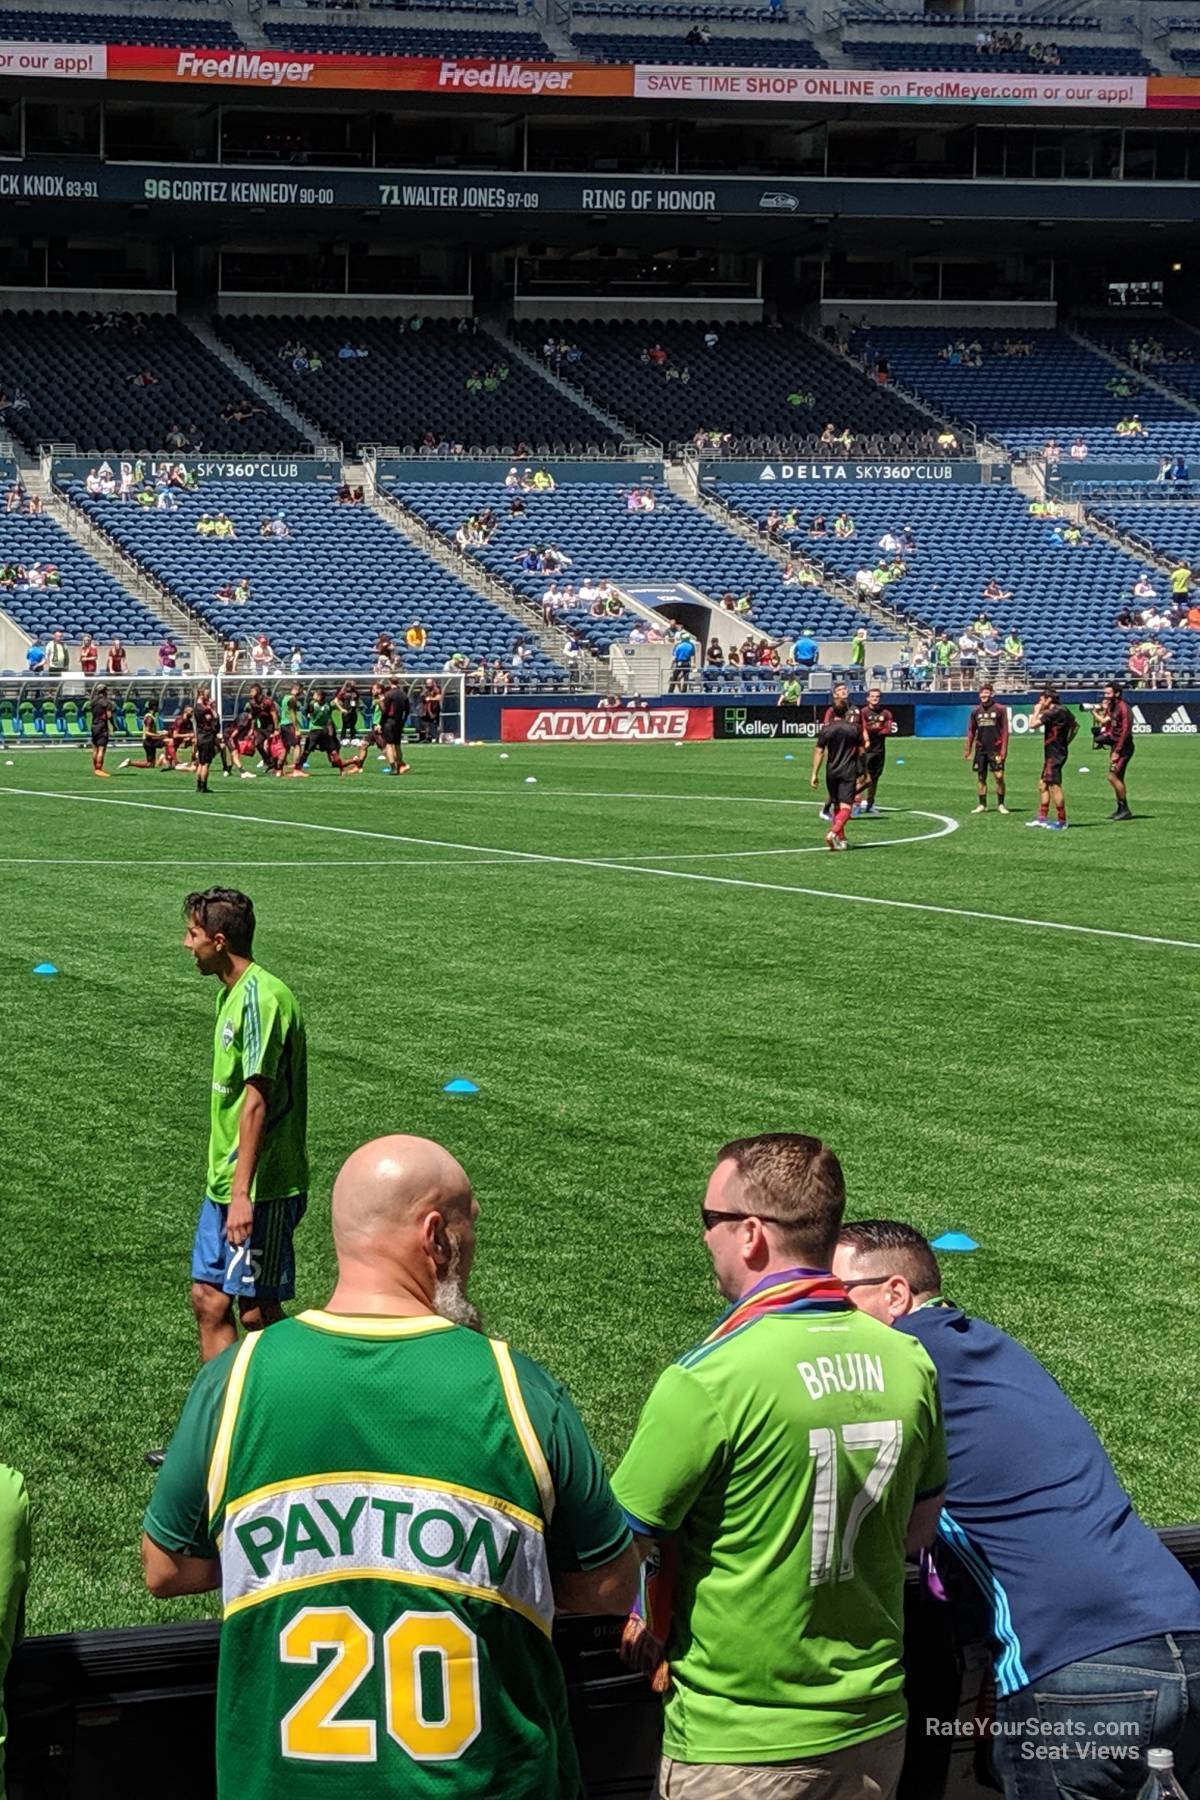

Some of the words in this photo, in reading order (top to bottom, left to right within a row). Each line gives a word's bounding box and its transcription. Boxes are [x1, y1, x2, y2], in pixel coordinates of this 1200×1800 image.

[19, 56, 48, 68] our
[54, 55, 92, 73] app!
[176, 52, 313, 86] FredMeyer
[438, 62, 572, 94] FredMeyer
[647, 76, 692, 91] SAVE
[697, 77, 740, 92] TIME
[746, 78, 797, 94] SHOP
[804, 79, 874, 96] ONLINE
[880, 84, 900, 96] on
[906, 82, 1038, 100] FredMeyer.com
[1043, 88, 1059, 98] or
[1065, 89, 1092, 100] our
[1097, 86, 1133, 103] app!
[23, 174, 63, 196] KNOX
[66, 181, 98, 197] 83-91
[144, 179, 171, 199] 96
[173, 180, 226, 202] CORTEZ
[231, 183, 298, 204] KENNEDY
[300, 188, 334, 204] 90-00
[379, 185, 400, 205] 71
[403, 186, 457, 207] WALTER
[460, 188, 505, 208] JONES
[507, 193, 539, 209] 97-09
[582, 188, 626, 209] RING
[631, 190, 653, 209] OF
[657, 191, 715, 210] HONOR
[120, 462, 187, 474] DLTA
[781, 465, 847, 479] DELTA
[528, 710, 688, 739] ADVOCARE
[736, 719, 776, 737] Kelley
[781, 719, 824, 737] Imagi
[1131, 723, 1152, 733] das
[1162, 721, 1198, 733] adidas
[796, 1353, 885, 1400] BRUIN
[808, 1419, 903, 1587] 17
[235, 1496, 520, 1585] PAYTON
[279, 1606, 482, 1762] 20
